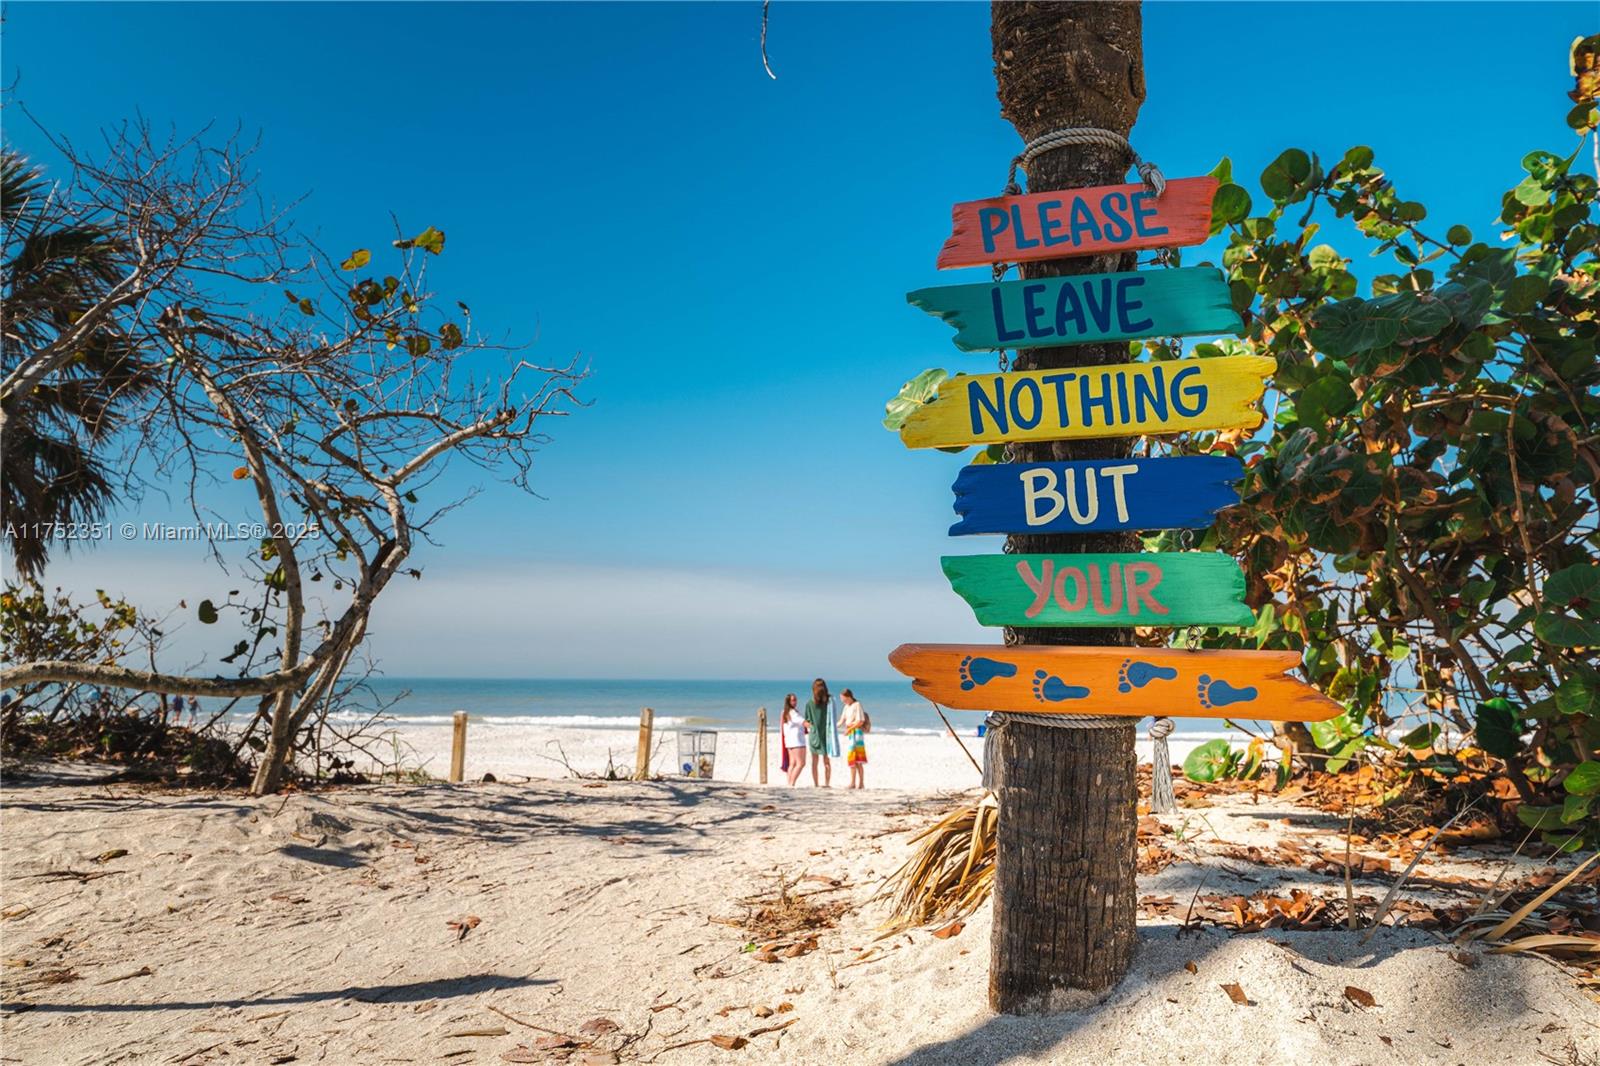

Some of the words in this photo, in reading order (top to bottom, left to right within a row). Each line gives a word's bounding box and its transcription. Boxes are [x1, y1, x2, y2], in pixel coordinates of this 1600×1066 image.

[979, 190, 1169, 253] PLEASE
[991, 277, 1154, 342] LEAVE
[968, 366, 1208, 435] NOTHING
[1019, 464, 1139, 526] BUT
[1015, 560, 1169, 618] YOUR
